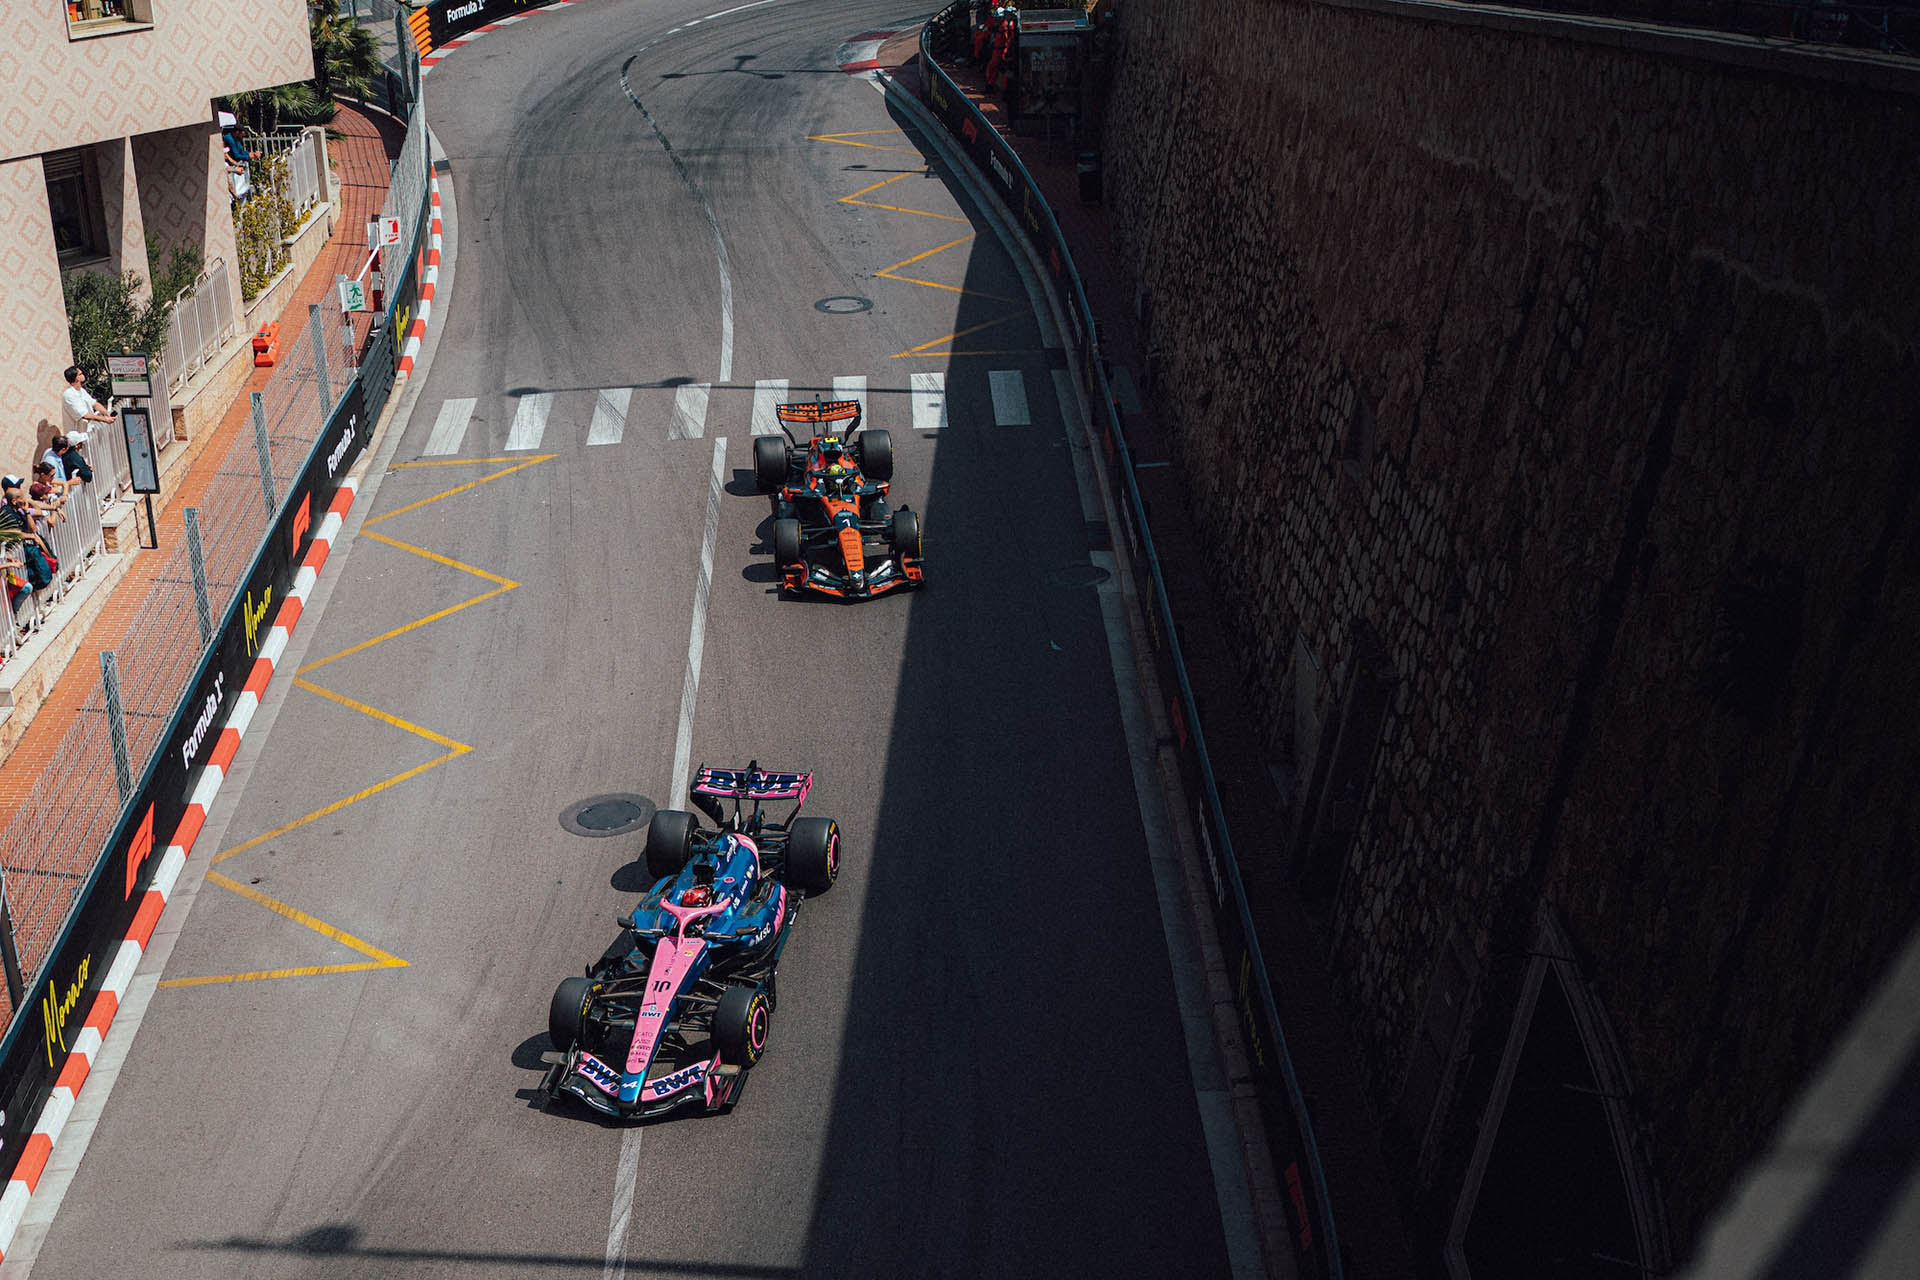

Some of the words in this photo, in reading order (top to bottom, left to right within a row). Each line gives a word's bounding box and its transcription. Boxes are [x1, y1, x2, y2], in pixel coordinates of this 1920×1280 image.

[447, 1, 477, 23] Formula
[327, 428, 351, 479] Formula
[243, 584, 273, 657] Monaco
[182, 693, 218, 770] Formula
[755, 922, 771, 945] MSC
[653, 980, 671, 992] 10
[43, 953, 91, 1068] Monaco
[651, 1065, 702, 1096] BWT
